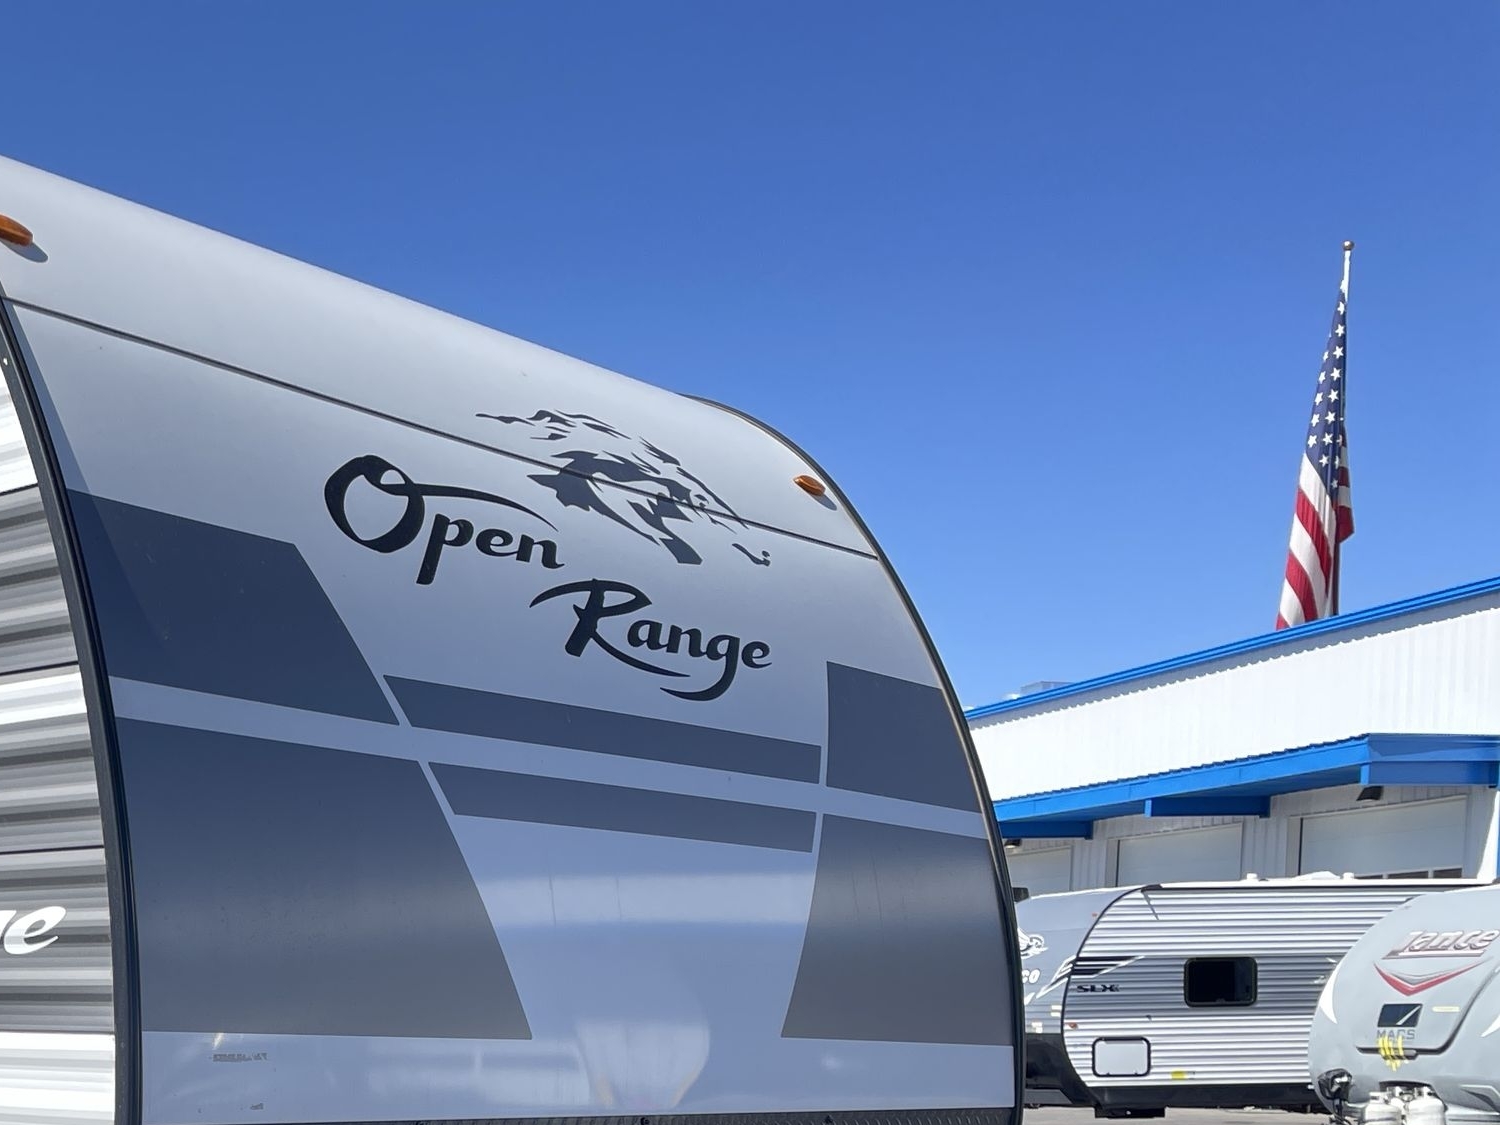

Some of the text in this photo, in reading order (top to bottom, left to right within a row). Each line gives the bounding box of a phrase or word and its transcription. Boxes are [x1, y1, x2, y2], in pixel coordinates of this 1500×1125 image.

[324, 454, 564, 585] Open
[529, 578, 772, 701] Range
[1402, 929, 1500, 952] Lance
